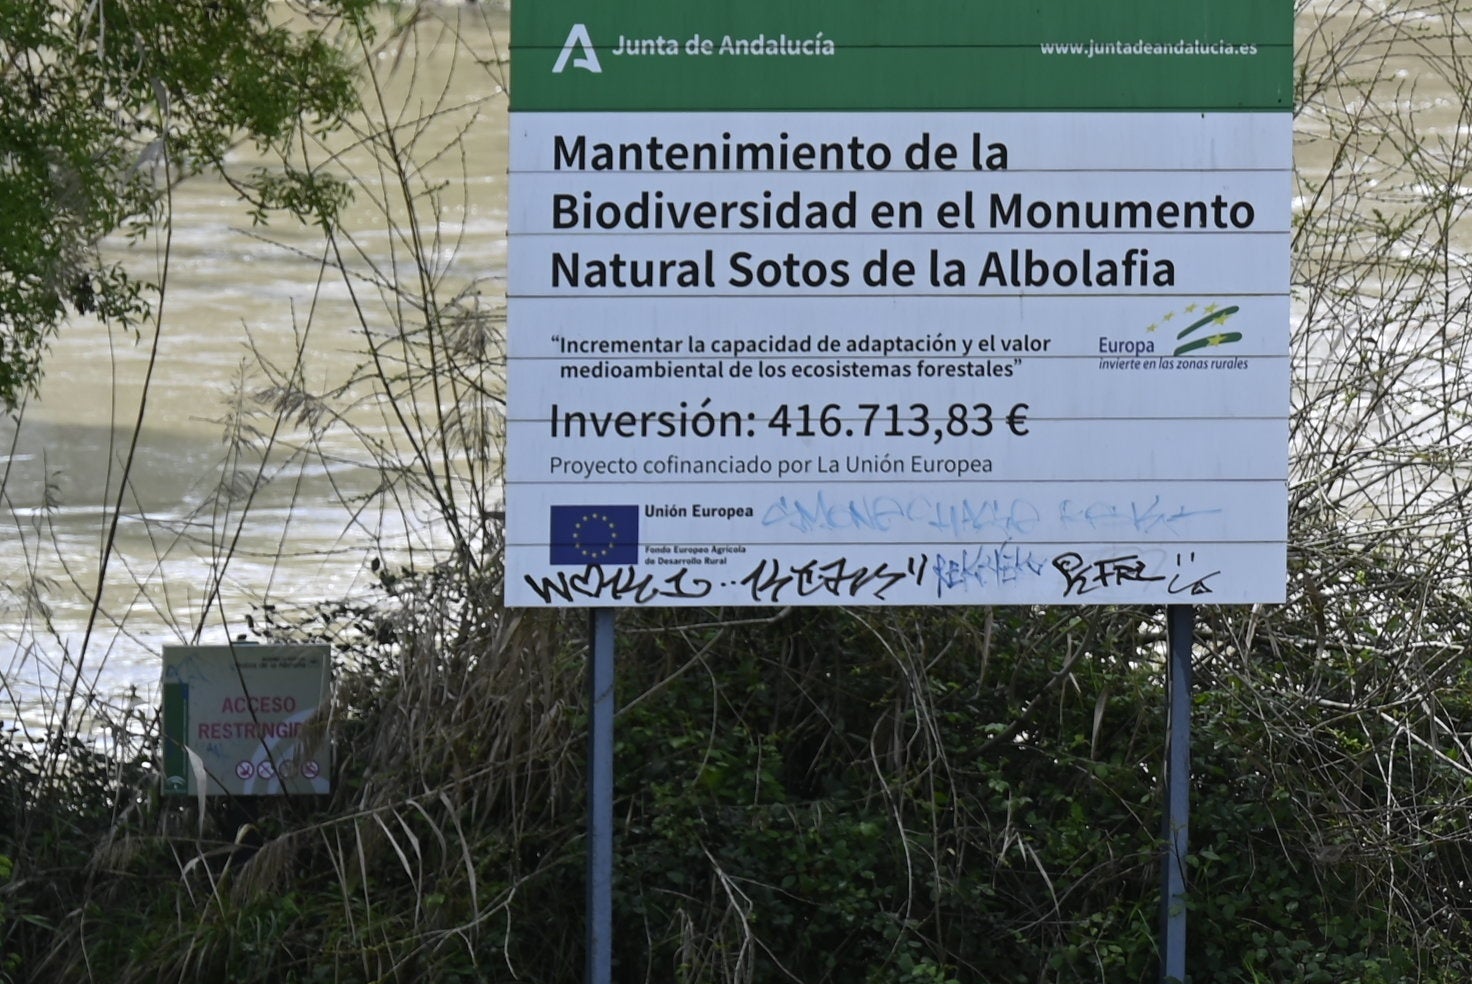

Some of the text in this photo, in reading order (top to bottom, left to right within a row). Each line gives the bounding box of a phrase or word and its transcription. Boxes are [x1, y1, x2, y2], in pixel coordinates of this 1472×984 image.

[612, 32, 835, 57] Junta de Andalucía
[1040, 39, 1258, 58] www.juntadeandalucia.es
[553, 132, 1008, 171] Mantenimiento de la
[552, 190, 1255, 230] Biodiversidad en el Monumento
[551, 249, 1176, 289] Natural Sotos de la Albolafia
[688, 335, 705, 354] la
[710, 335, 812, 356] capacidad
[817, 335, 841, 354] de
[846, 333, 957, 358] adaptación
[962, 340, 973, 357] y
[979, 335, 996, 353] el
[1000, 335, 1052, 353] valor
[1099, 337, 1155, 356] Europa
[559, 358, 724, 378] medioambiental
[728, 360, 753, 378] de
[758, 360, 787, 378] los
[791, 360, 912, 378] ecosistemas
[1099, 357, 1249, 370] invierte en las zonas rurales
[549, 398, 1030, 445] Inversión: 416.713,83 €
[550, 453, 993, 479] Proyecto cofinanciado por La Unión Europea
[644, 504, 754, 520] Unión Europea
[645, 545, 672, 555] Fondo
[674, 545, 709, 556] Europeo
[645, 556, 727, 565] de Desarrollo Rural
[222, 696, 297, 713] ACCESO
